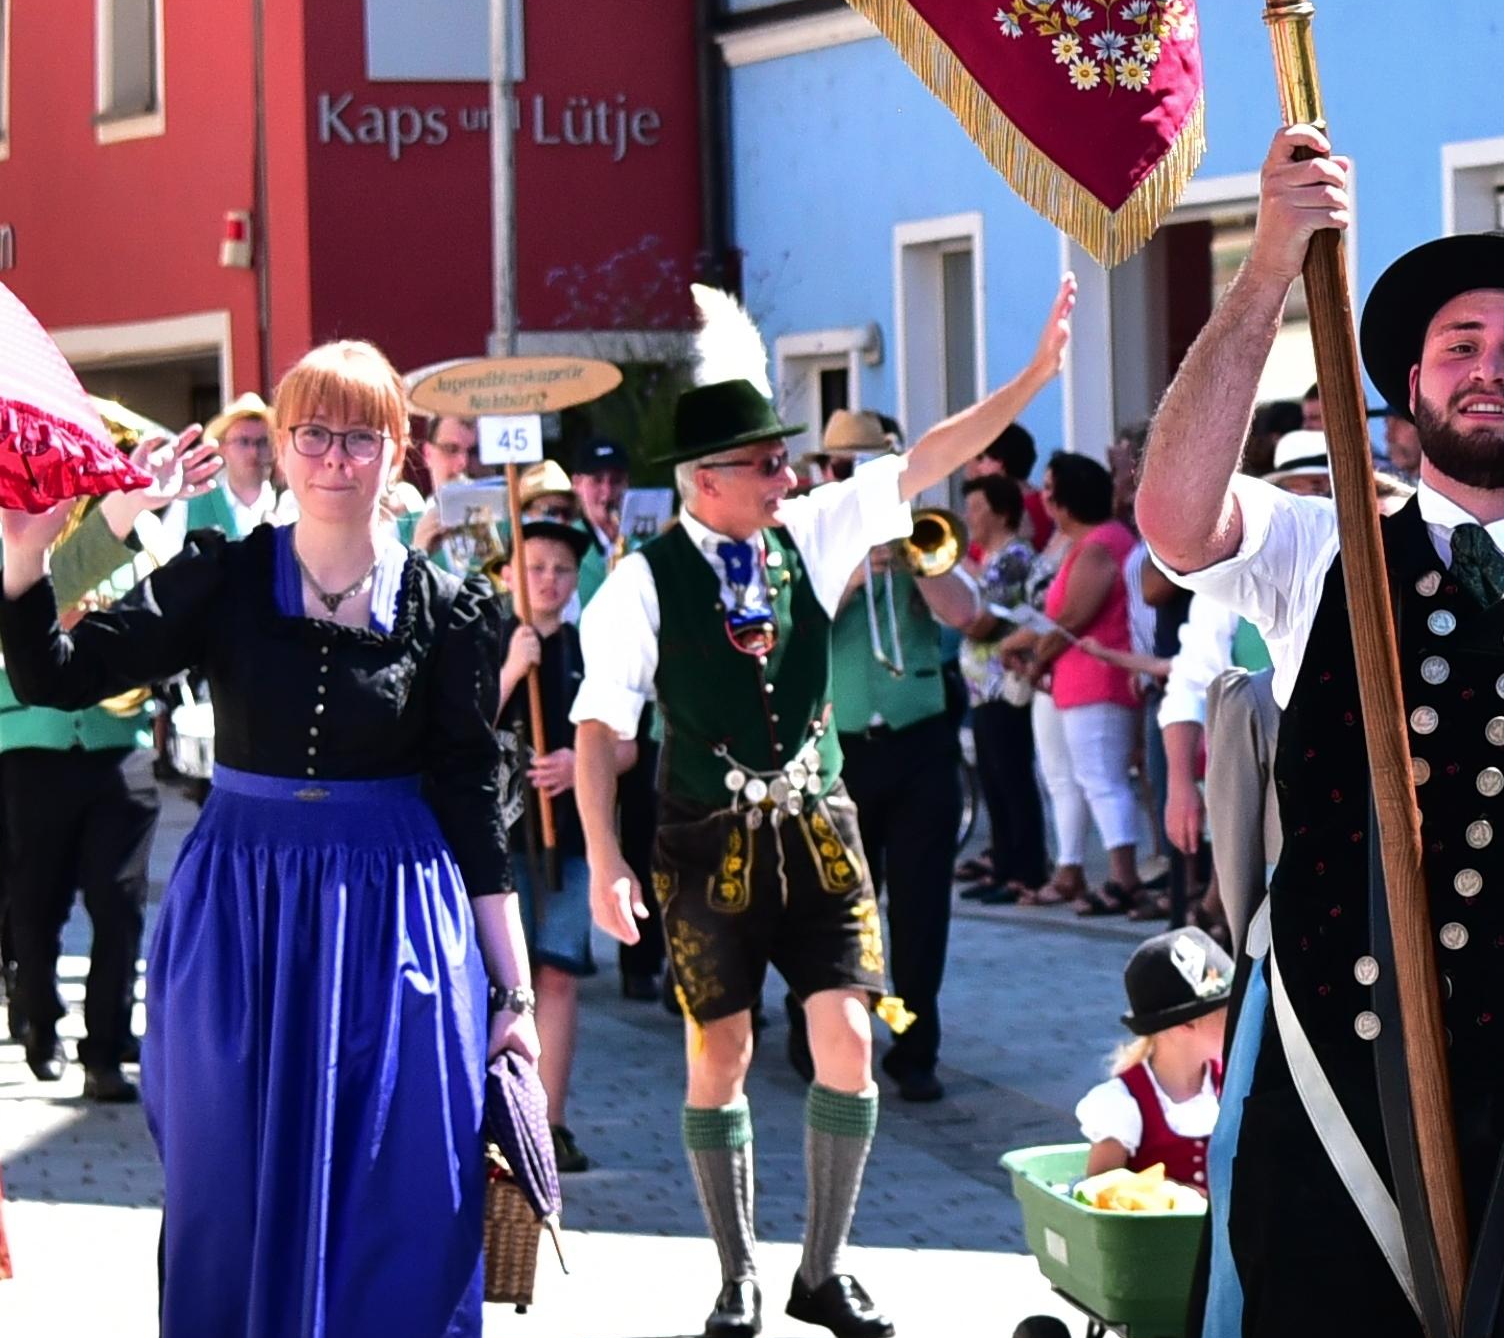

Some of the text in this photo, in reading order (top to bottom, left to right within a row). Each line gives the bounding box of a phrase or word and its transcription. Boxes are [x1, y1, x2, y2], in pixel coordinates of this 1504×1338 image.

[317, 92, 449, 161] Kaps
[532, 92, 662, 161] Lütje
[498, 428, 528, 452] 45
